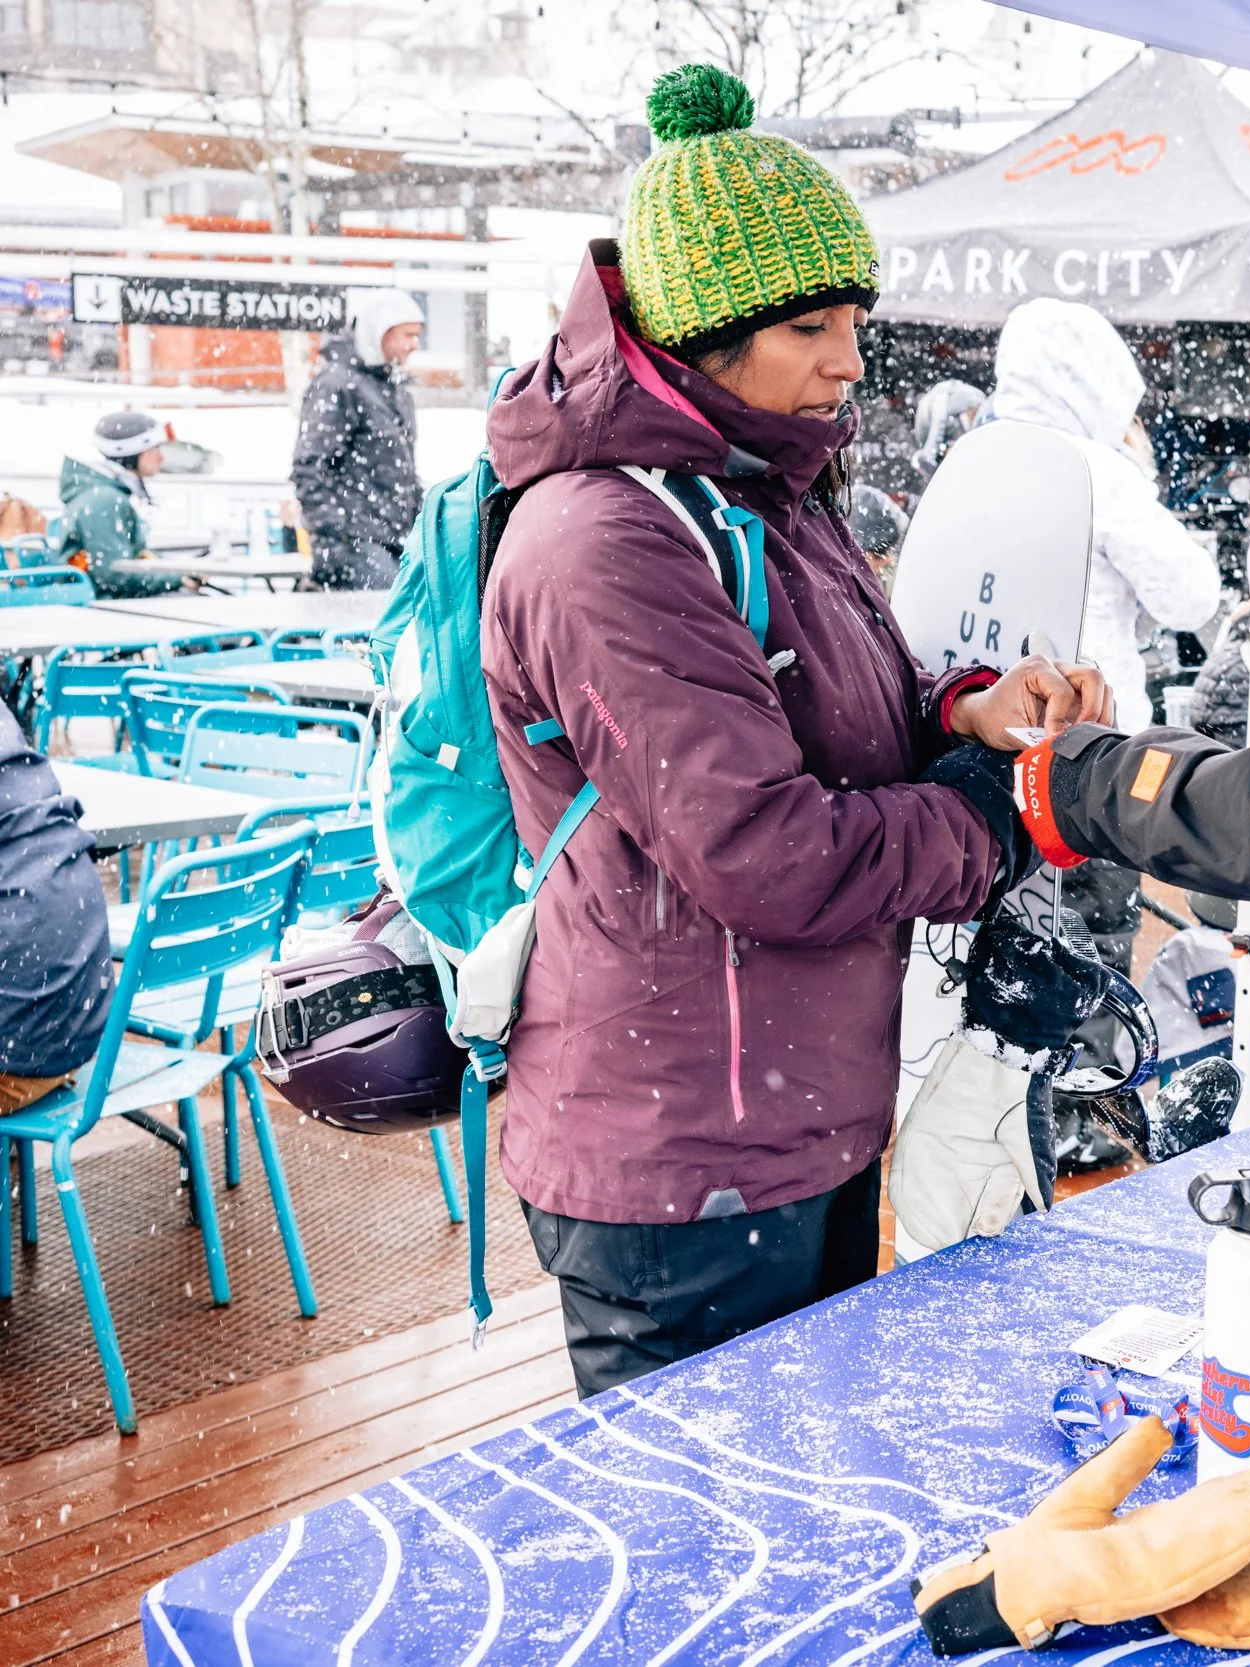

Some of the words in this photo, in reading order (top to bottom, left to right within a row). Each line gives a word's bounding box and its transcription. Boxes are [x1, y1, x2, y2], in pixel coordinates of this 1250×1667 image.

[887, 247, 1031, 293] PARK
[1053, 248, 1196, 297] CITY
[126, 286, 222, 317] WASTE
[226, 292, 342, 321] STATION
[580, 680, 628, 750] patagonia
[1027, 753, 1042, 819] TOYOTA
